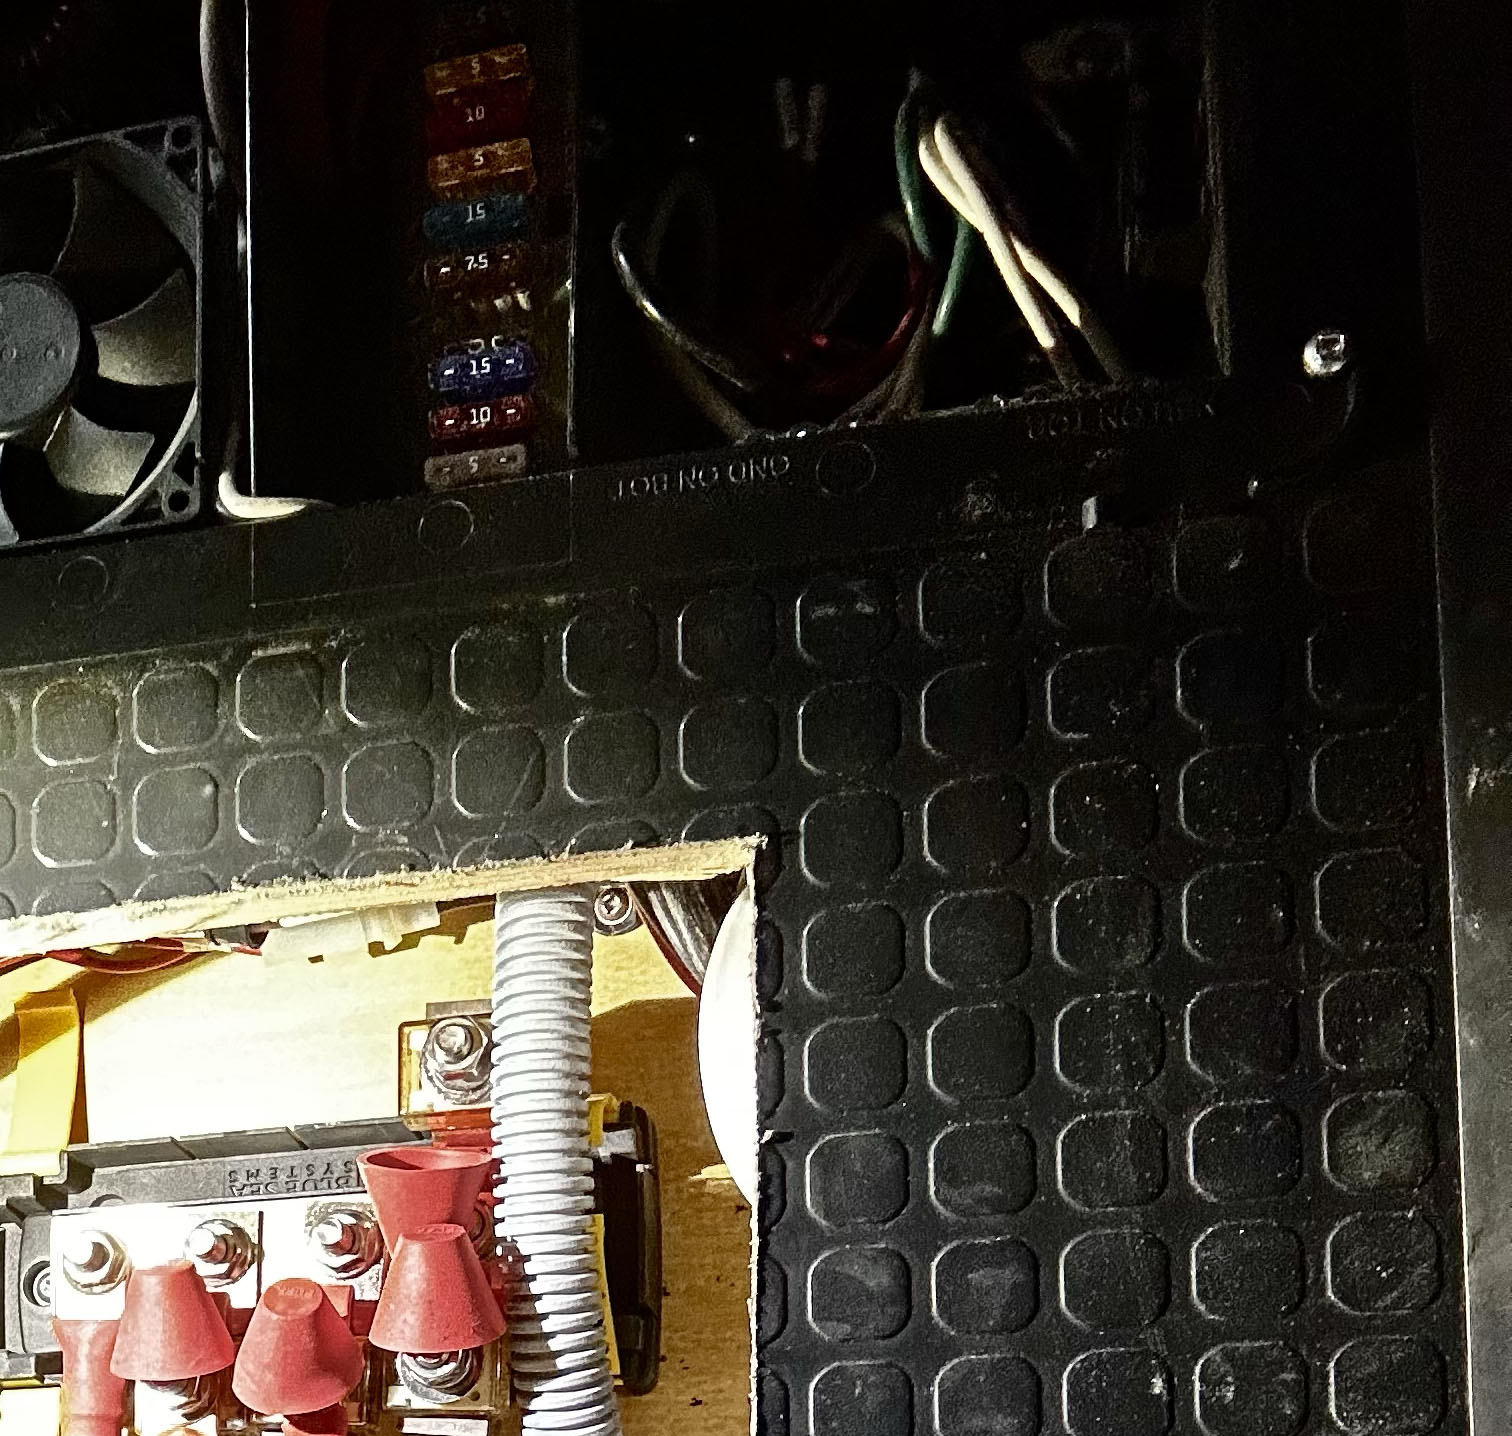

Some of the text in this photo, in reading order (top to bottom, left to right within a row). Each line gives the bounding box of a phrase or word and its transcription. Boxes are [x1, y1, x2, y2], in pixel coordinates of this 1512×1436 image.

[464, 105, 485, 123] 10
[472, 149, 484, 167] 5
[464, 201, 487, 224] 15
[464, 251, 489, 272] 7.5
[469, 356, 491, 376] 15
[469, 406, 491, 425] 10
[227, 1160, 354, 1184] SYSTEMS
